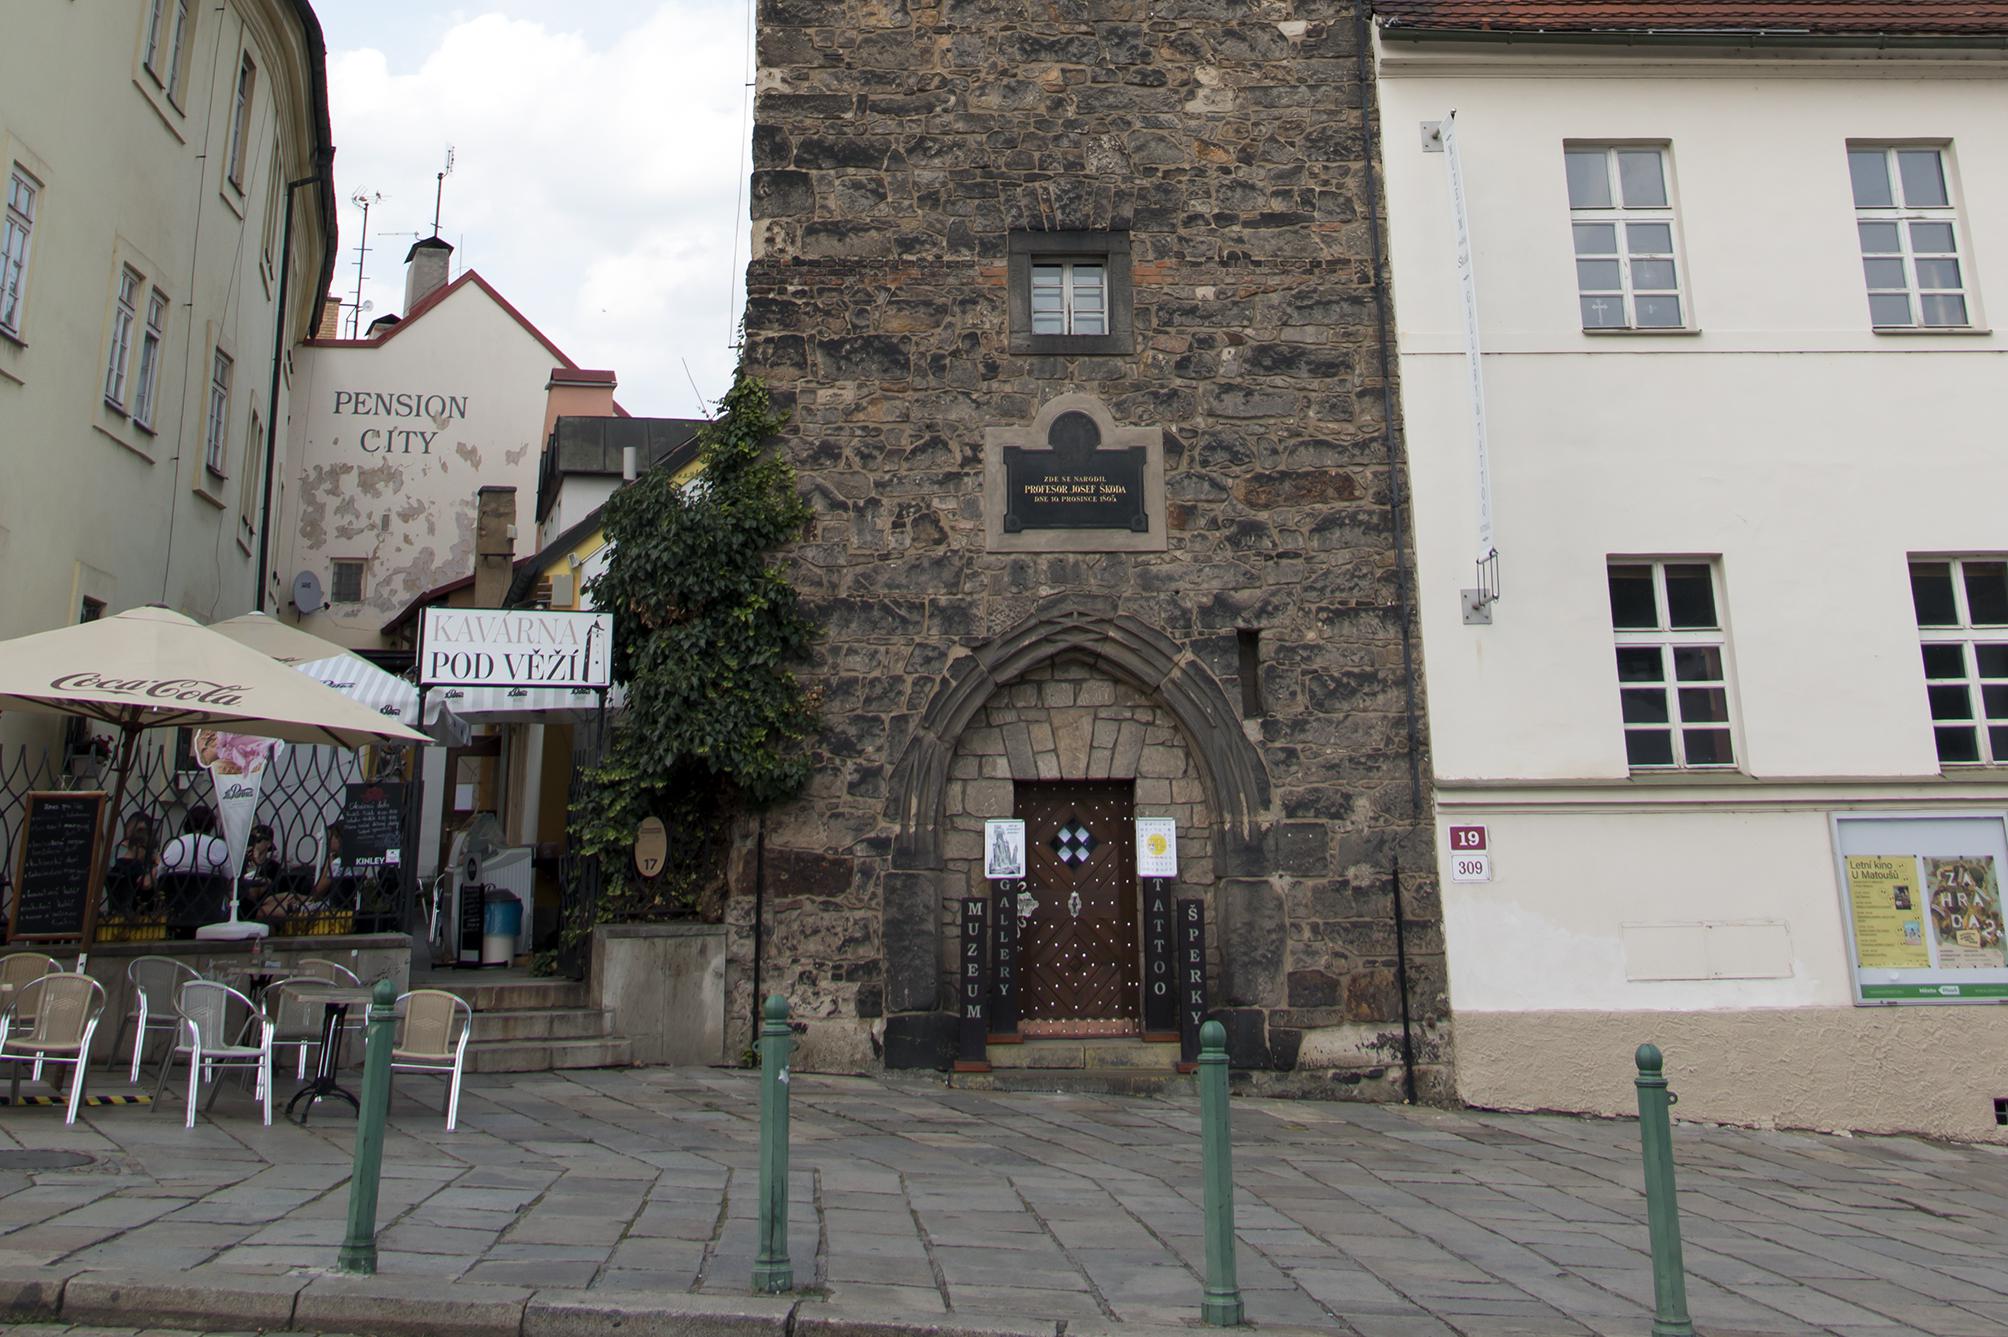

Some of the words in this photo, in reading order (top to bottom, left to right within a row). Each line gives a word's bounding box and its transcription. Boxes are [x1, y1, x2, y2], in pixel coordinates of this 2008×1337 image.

[333, 391, 468, 419] PENSION
[360, 428, 438, 454] CITY
[1024, 484, 1068, 494] PROFESOR
[1071, 484, 1096, 494] JOSEF
[1099, 482, 1126, 494] ŠKODA
[432, 610, 578, 645] KAVÁRNA
[430, 651, 494, 680] POD
[503, 648, 579, 681] VĚŽÍ
[50, 672, 254, 706] Coca-Cola
[1458, 831, 1480, 846] 19
[355, 856, 386, 865] KINLEY
[644, 857, 658, 871] 17
[1458, 861, 1483, 875] 309
[1850, 860, 1872, 870] Letní
[1873, 860, 1893, 869] kino
[1851, 870, 1858, 879] U
[1861, 869, 1899, 880] Matoušů
[999, 879, 1011, 996] GALLERY
[1153, 878, 1166, 996] TATTOO
[966, 902, 983, 1019] MUZEUM
[1188, 904, 1203, 1025] ŠPERKY
